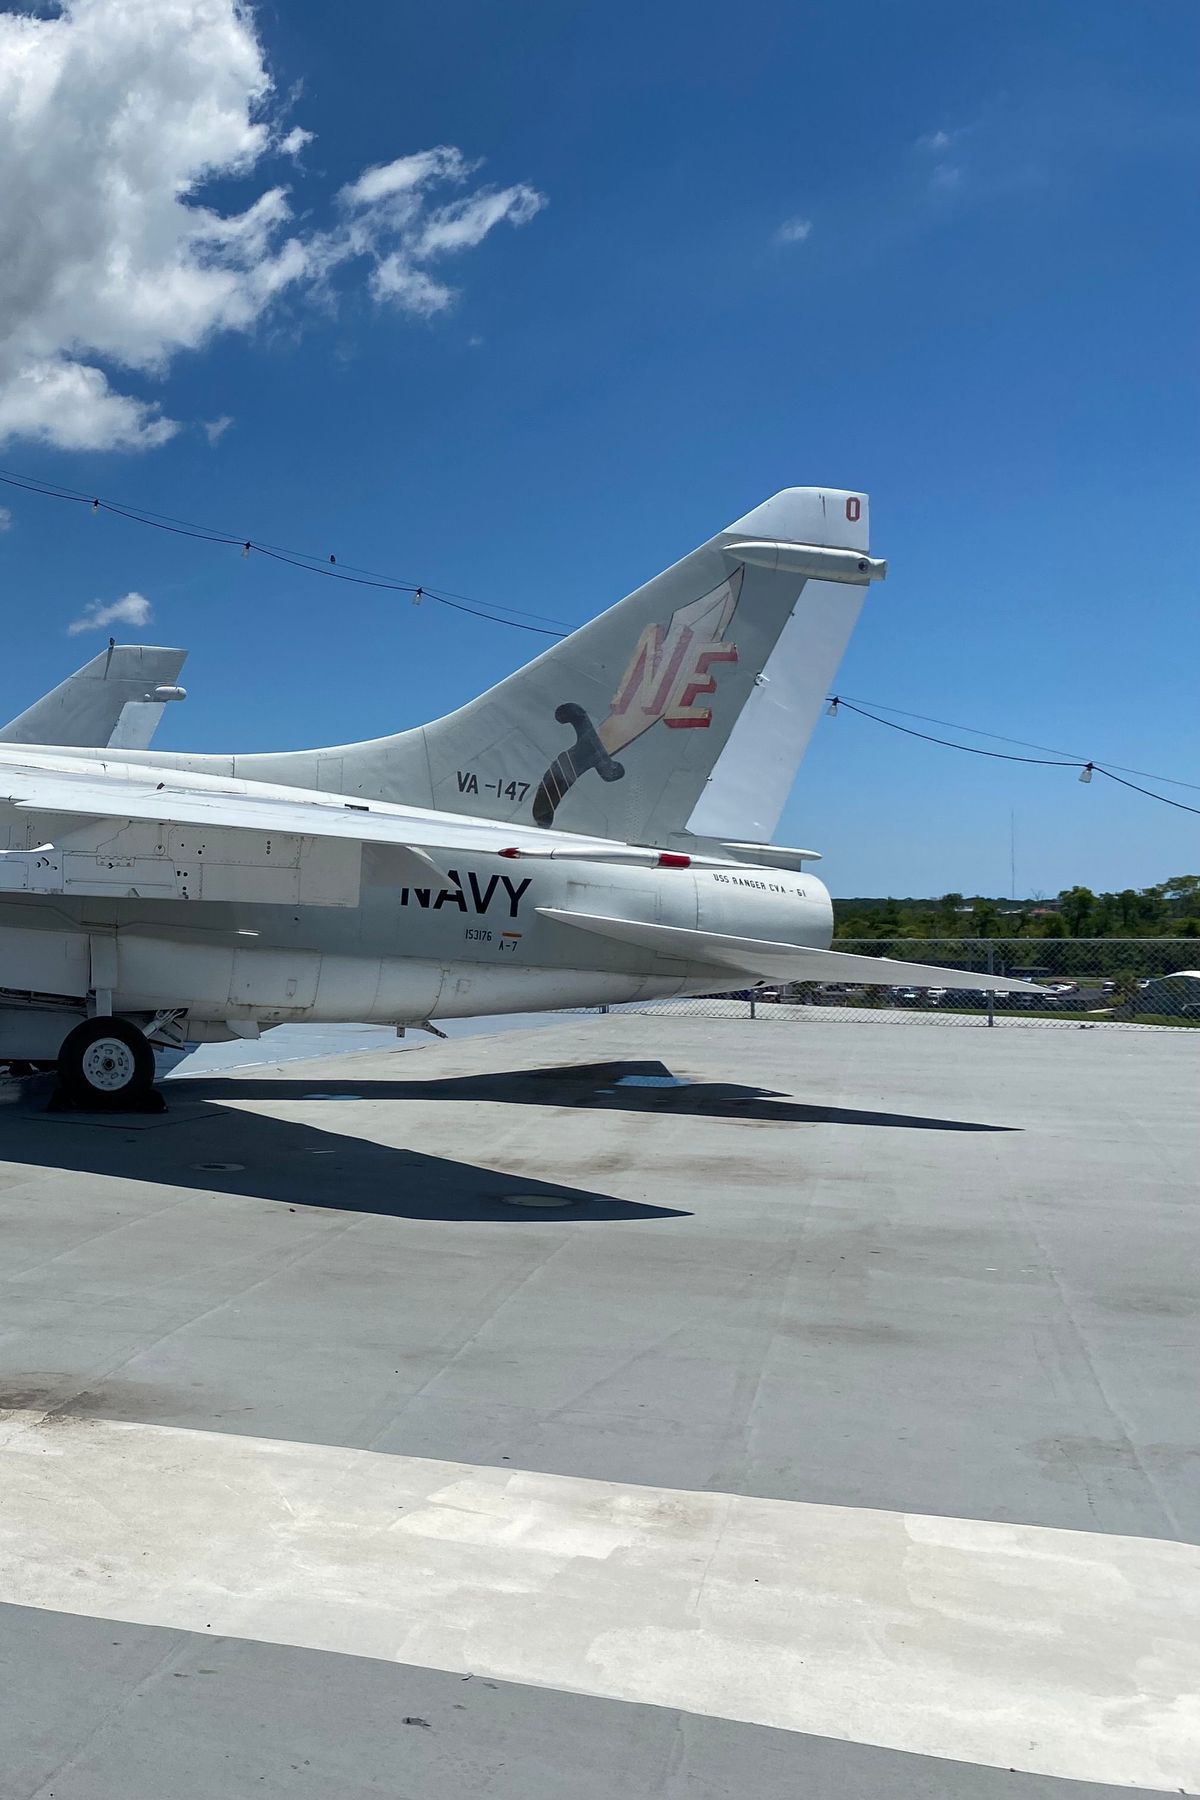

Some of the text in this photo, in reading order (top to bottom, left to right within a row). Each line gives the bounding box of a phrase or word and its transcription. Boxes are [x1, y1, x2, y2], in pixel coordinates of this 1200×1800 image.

[610, 622, 738, 729] NE
[713, 873, 730, 884] USS
[732, 876, 767, 890] RANGER
[465, 929, 493, 942] 153176
[498, 941, 518, 952] A-7
